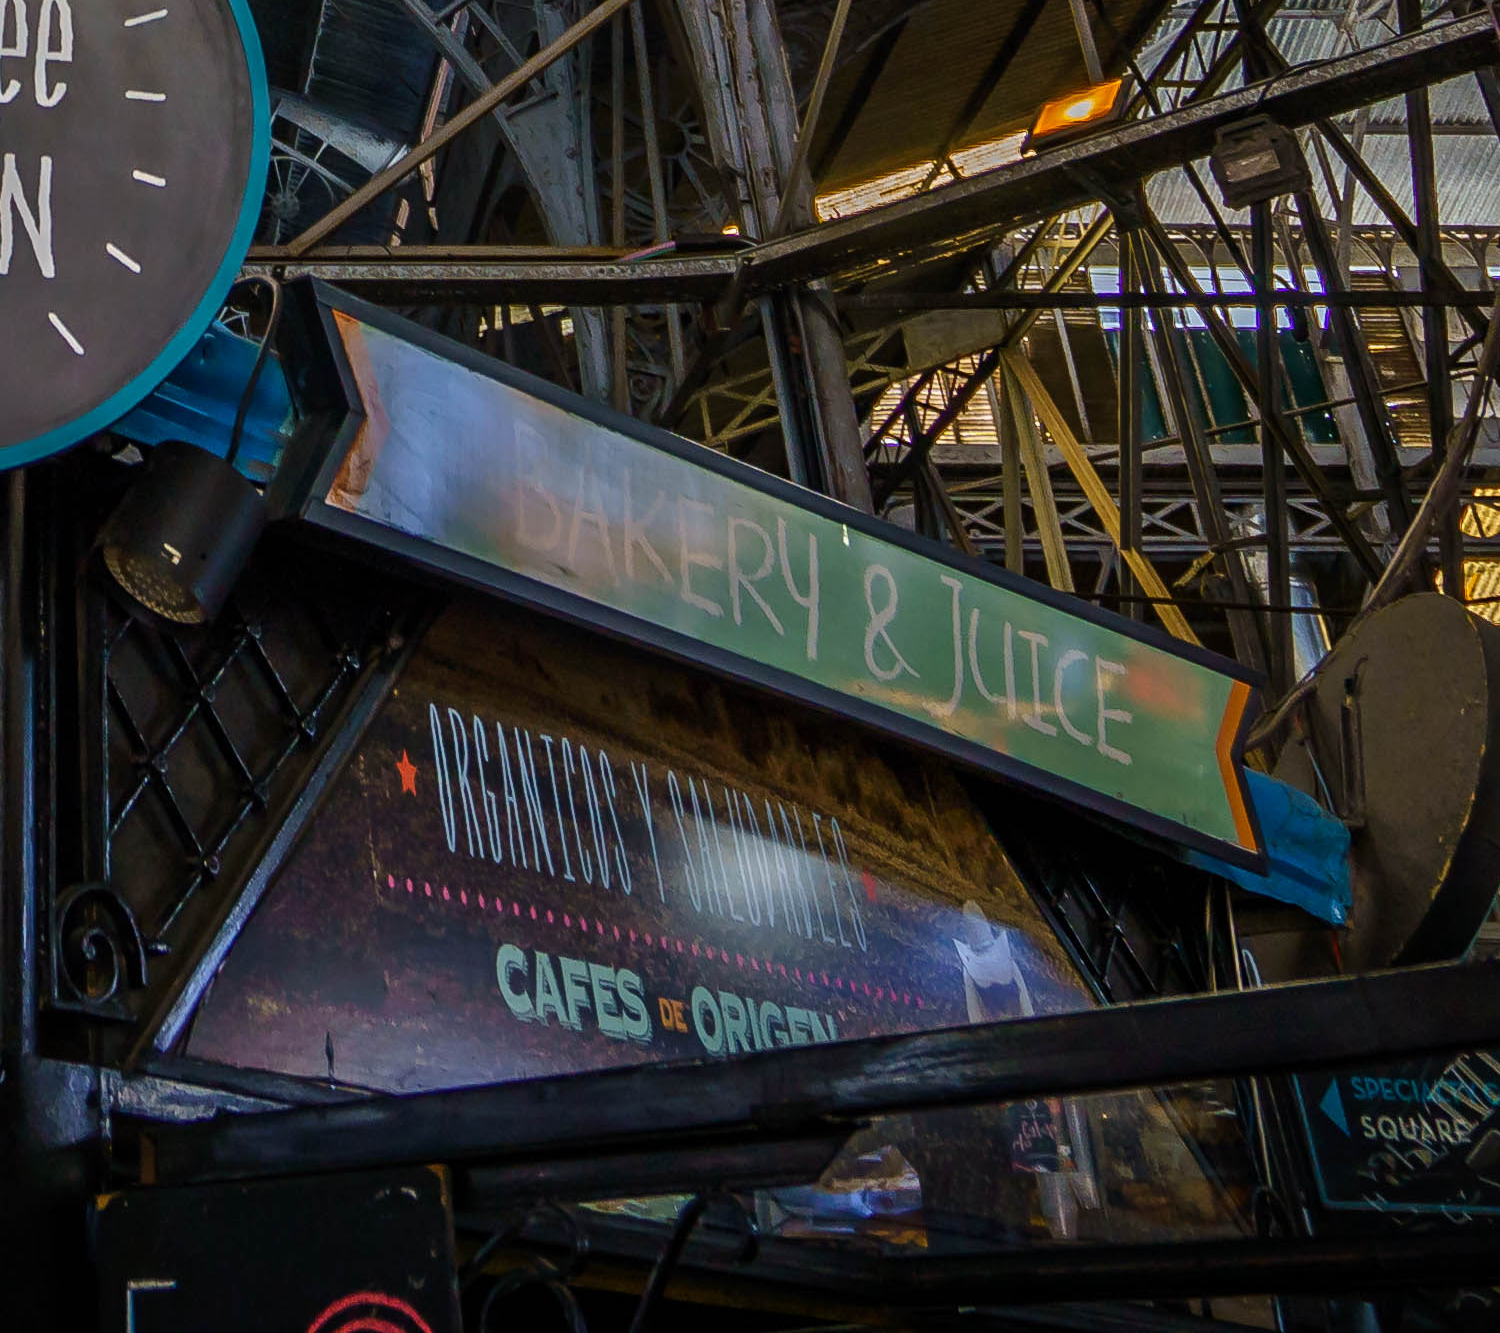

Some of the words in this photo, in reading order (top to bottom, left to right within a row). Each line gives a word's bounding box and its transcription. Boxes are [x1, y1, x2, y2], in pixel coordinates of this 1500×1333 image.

[512, 423, 820, 661] BAKERY
[864, 565, 920, 682] &
[925, 574, 1135, 766] JUICE
[429, 703, 632, 895] ORGANICOS
[631, 760, 665, 903] Y
[666, 770, 868, 952] SALUDABLES
[496, 943, 654, 1044] CAFES
[659, 997, 689, 1034] DE
[1360, 1115, 1472, 1143] SQUARE
